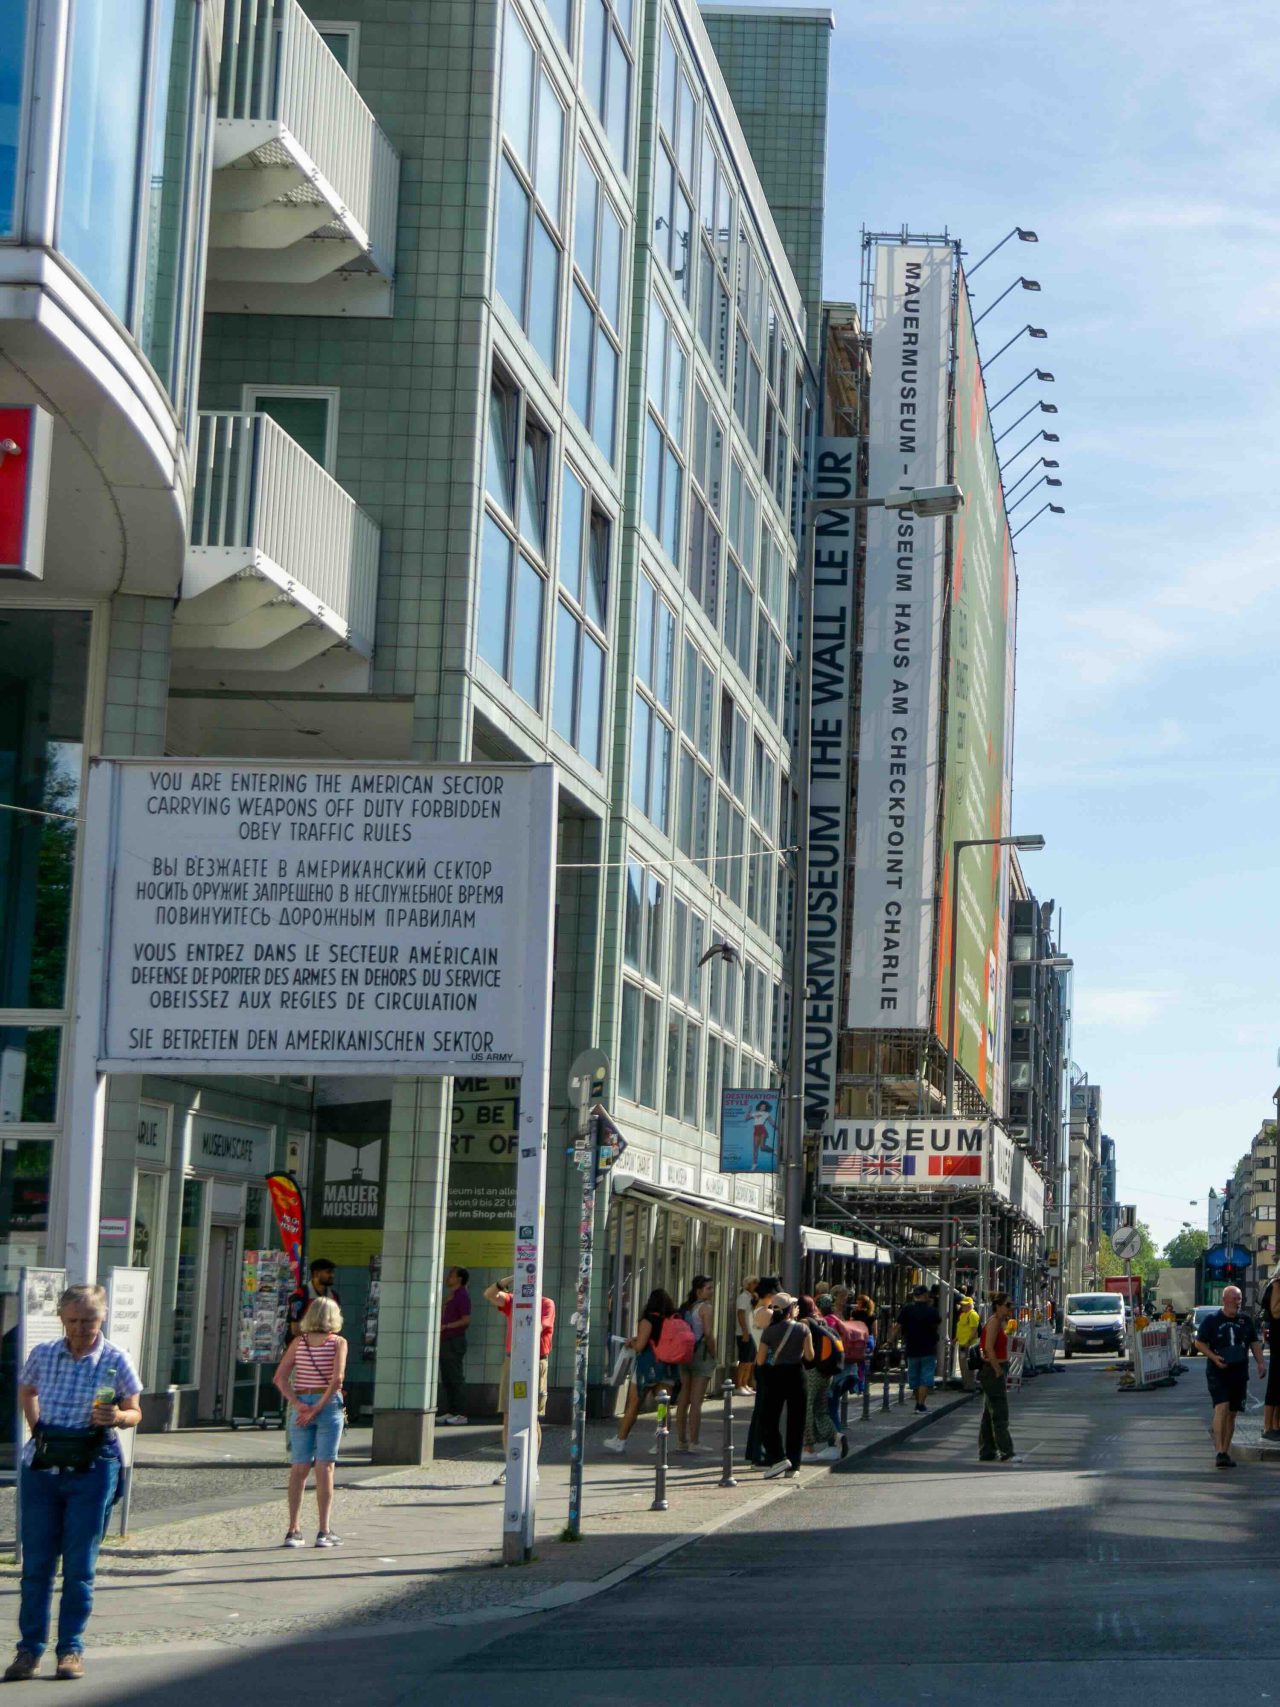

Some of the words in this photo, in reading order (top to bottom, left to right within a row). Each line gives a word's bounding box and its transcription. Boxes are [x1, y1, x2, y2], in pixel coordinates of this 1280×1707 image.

[899, 262, 922, 453] MAUERMUSEUM
[814, 450, 853, 537] MUR
[896, 486, 915, 592] USEUM
[814, 550, 849, 586] LE
[894, 604, 911, 668] HAUS
[811, 606, 847, 706] WALL
[892, 679, 909, 715] AM
[810, 718, 843, 785] THE
[149, 772, 182, 791] YOU
[191, 773, 222, 791] ARE
[231, 773, 307, 793] ENTERING
[316, 774, 341, 793] THE
[351, 775, 433, 794] AMERICAN
[442, 776, 504, 795] SECTOR
[147, 796, 231, 815] CARRYING
[238, 797, 317, 817] WEAPONS
[325, 799, 354, 818] OFF
[364, 799, 403, 818] DUTY
[412, 799, 501, 818] FORBIDDEN
[886, 727, 908, 889] CHECKPOINT
[239, 821, 281, 841] OBEY
[290, 822, 354, 842] TRAFFIC
[363, 823, 412, 842] RULES
[153, 857, 177, 876] ВЫ
[278, 859, 288, 878] В
[296, 858, 426, 879] АМЕРИКАНСКИЙ
[434, 861, 492, 880] СЕКТОР
[136, 881, 188, 900] НОСИТЬ
[193, 882, 249, 901] ОРУЖИЕ
[340, 884, 349, 902] В
[355, 884, 453, 903] НЕСЛУЖЕБНОЕ
[458, 885, 503, 904] ВРЕМЯ
[279, 907, 375, 927] ДОРОЖНЫМ
[386, 908, 476, 928] ПРАВИЛАМ
[134, 942, 177, 962] VOUS
[186, 943, 244, 962] ENTREZ
[254, 943, 297, 962] DANS
[305, 944, 320, 962] LE
[329, 944, 399, 964] SECTEUR
[409, 940, 498, 965] AMÉRICAIN
[803, 805, 841, 1119] MAUERMUSEUM
[881, 901, 902, 1010] CHARLIE
[131, 966, 188, 985] DEFENSE
[193, 967, 209, 985] DE
[211, 967, 260, 985] PORTER
[264, 968, 289, 986] DES
[292, 968, 336, 986] ARMES
[342, 968, 358, 986] EN
[365, 968, 417, 987] DEHORS
[423, 969, 441, 987] DU
[446, 969, 501, 987] SERVICE
[150, 990, 229, 1008] OBEISSEZ
[239, 991, 272, 1009] AUX
[280, 991, 337, 1009] REGLES
[347, 992, 365, 1010] DE
[375, 992, 477, 1011] CIRCULATION
[129, 1028, 154, 1049] SIE
[163, 1028, 239, 1050] BETRETEN
[247, 1029, 278, 1050] DEN
[285, 1030, 425, 1052] AMERIKANISCHEN
[433, 1030, 494, 1052] SEKTOR
[471, 1053, 483, 1061] US
[486, 1053, 513, 1061] ARMY
[454, 1077, 490, 1093] ME
[477, 1105, 505, 1124] BE
[451, 1134, 475, 1154] RT
[822, 1128, 983, 1151] MUSEUM
[323, 1185, 379, 1202] MAUER
[448, 1187, 473, 1195] seum
[499, 1186, 517, 1195] alle
[494, 1198, 506, 1206] 22
[321, 1202, 379, 1217] MUSEUM
[471, 1210, 497, 1220] Shop
